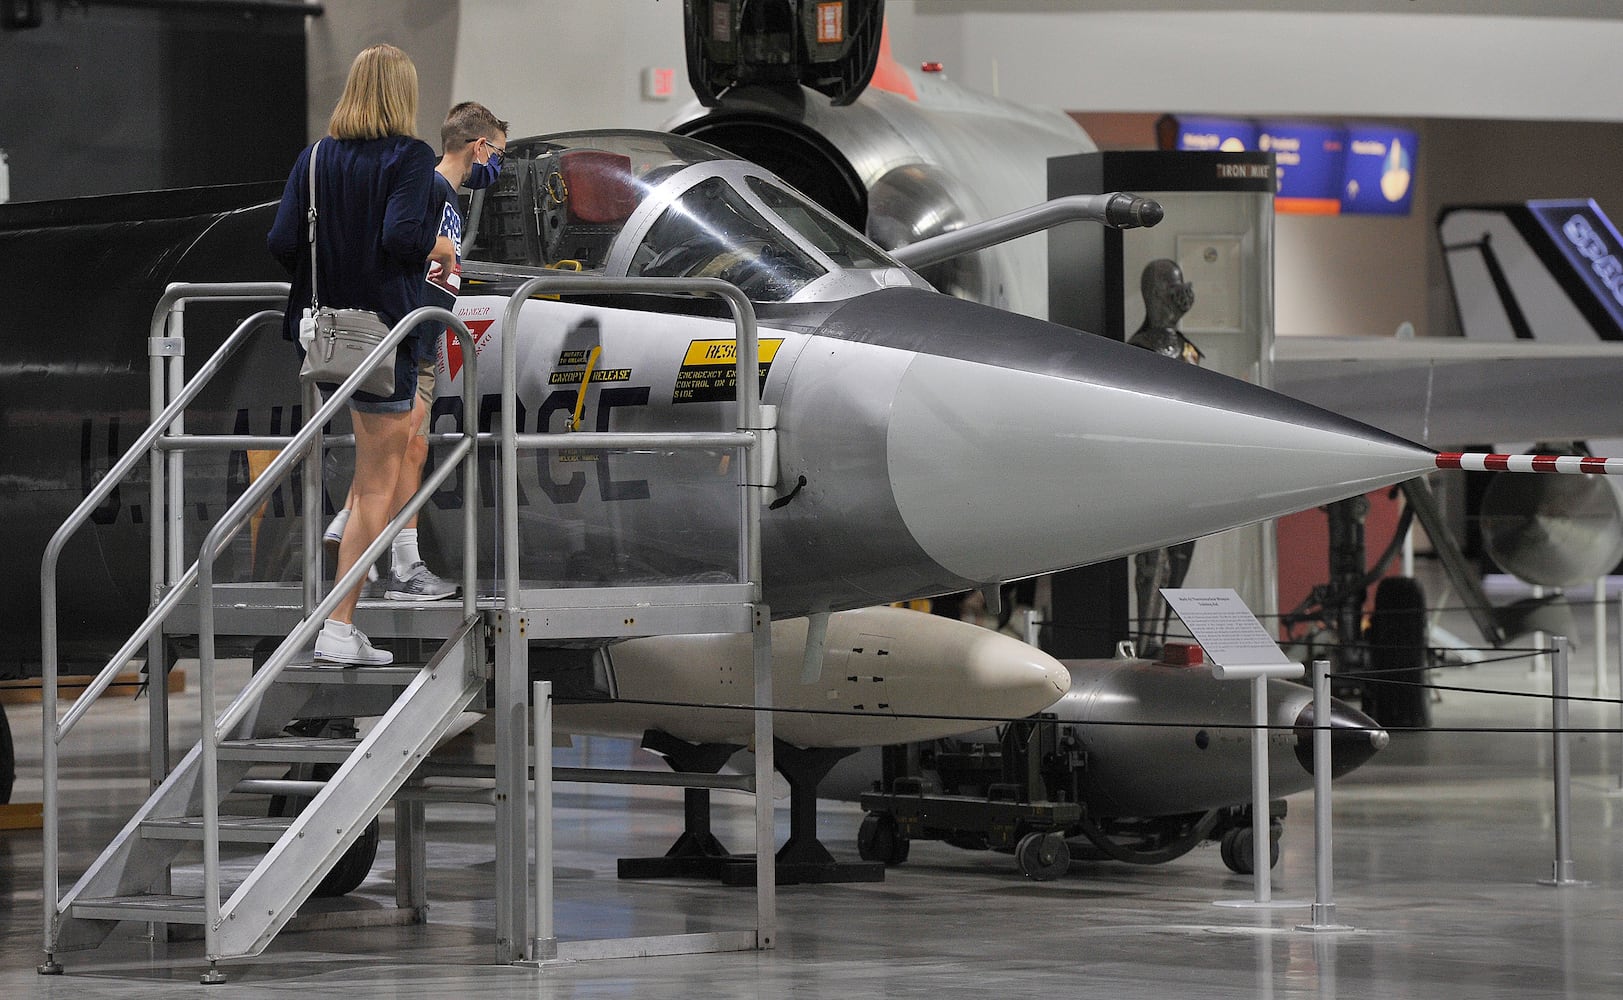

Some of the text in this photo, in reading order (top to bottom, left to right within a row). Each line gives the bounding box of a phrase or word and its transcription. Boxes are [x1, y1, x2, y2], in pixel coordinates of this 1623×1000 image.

[552, 369, 631, 383] CANOPY RELEASE
[678, 370, 722, 380] EMERGENCY
[675, 379, 710, 389] CONTROL
[673, 390, 694, 398] SIDE
[426, 386, 651, 511] ORCE
